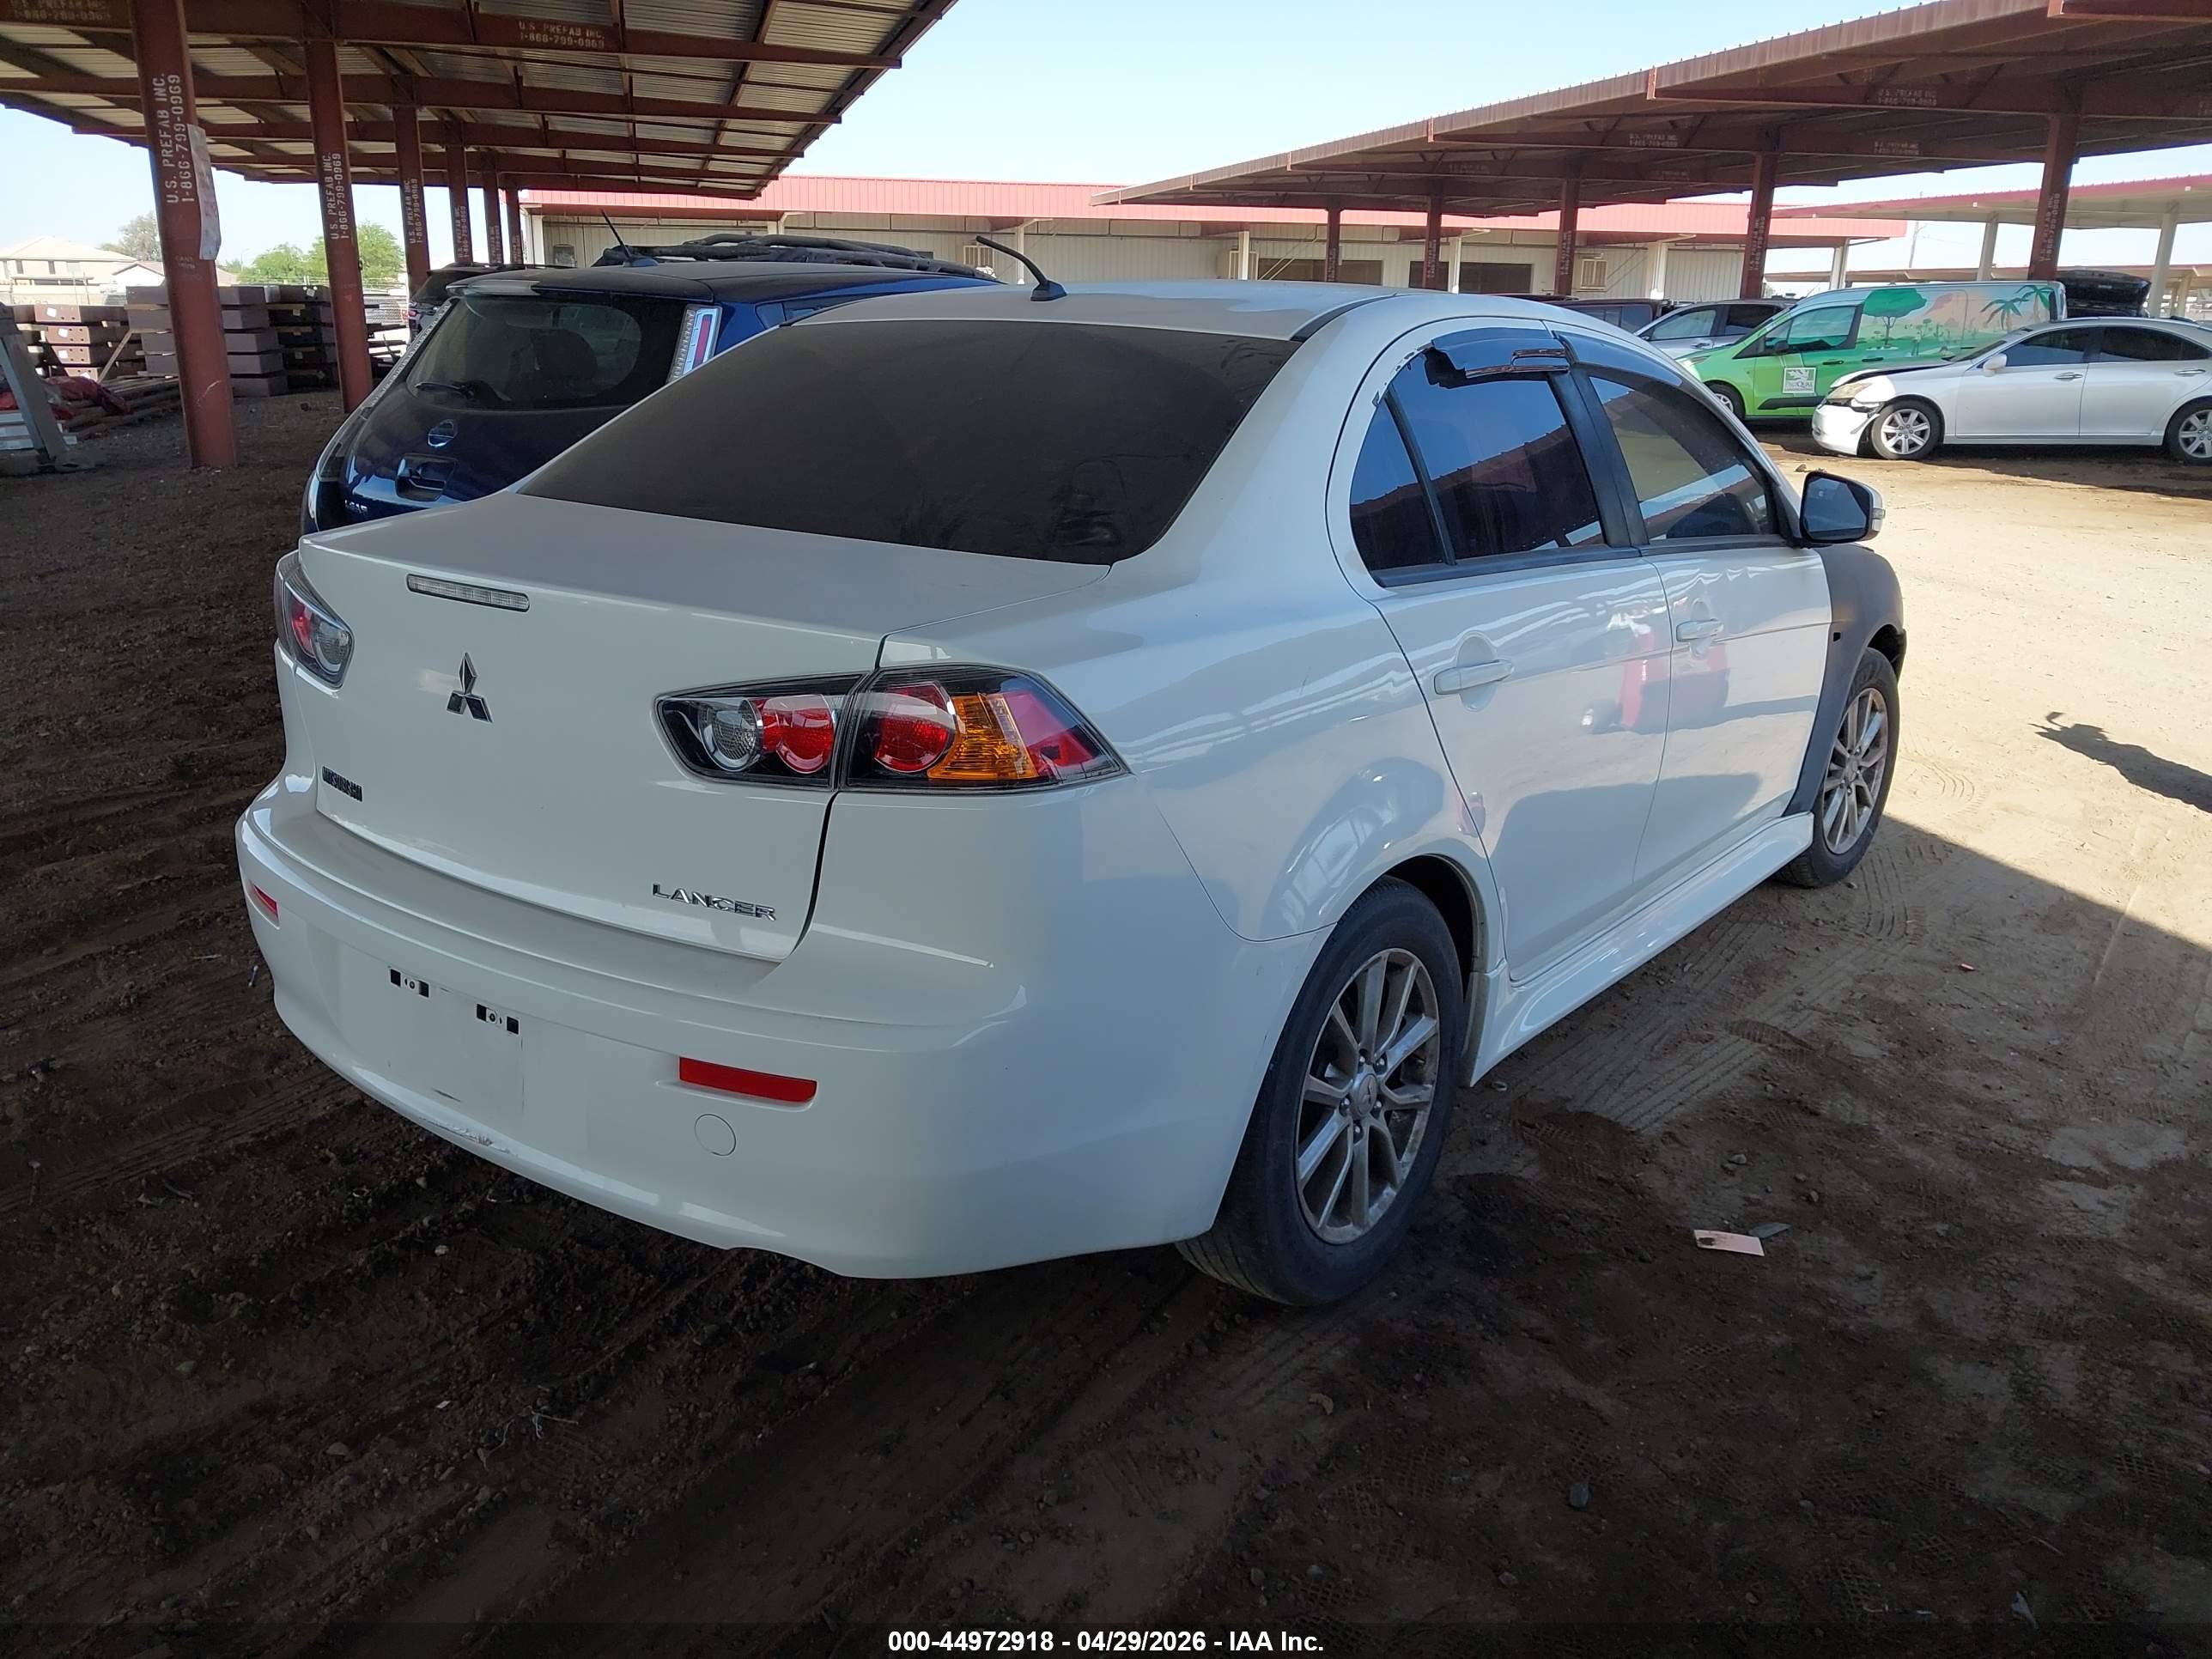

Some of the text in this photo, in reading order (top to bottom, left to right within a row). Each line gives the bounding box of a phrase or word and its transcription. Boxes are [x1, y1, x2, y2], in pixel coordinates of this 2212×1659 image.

[153, 73, 179, 204] U.S. PREFAB INC.
[167, 75, 195, 202] 1-866-799-0969
[325, 176, 337, 216] PREFAB
[332, 153, 349, 239] 1-866-799-0969
[653, 884, 776, 921] LANCER
